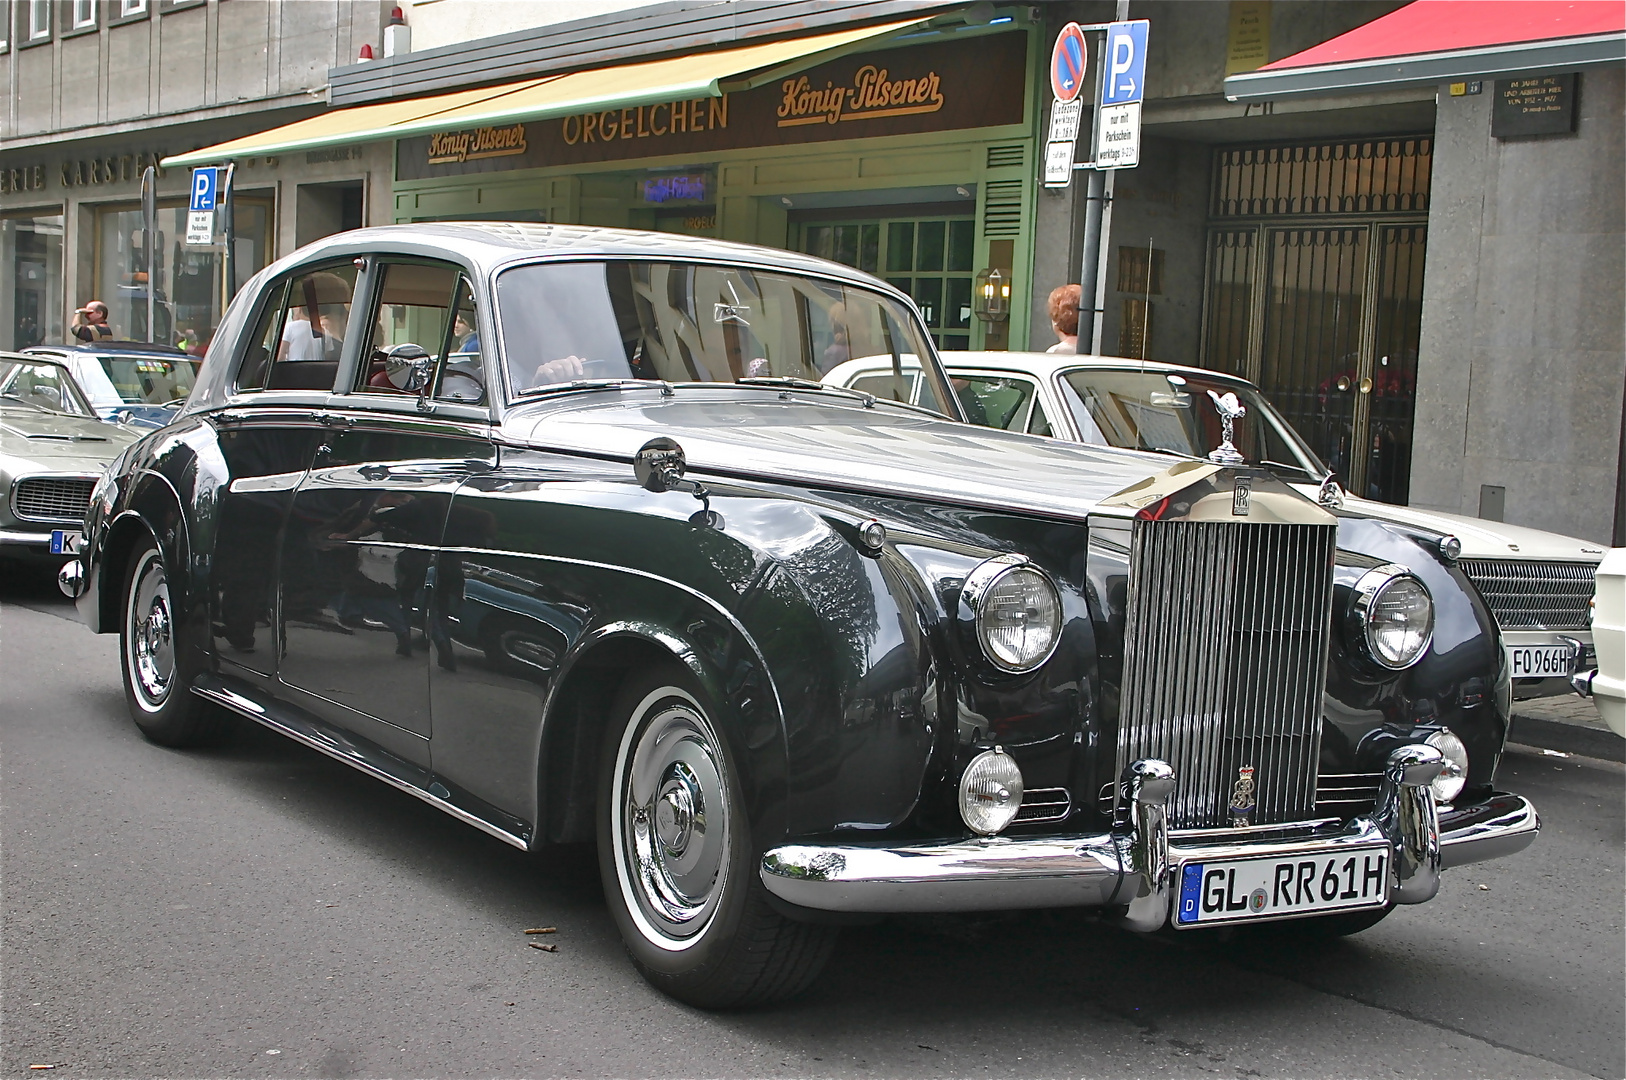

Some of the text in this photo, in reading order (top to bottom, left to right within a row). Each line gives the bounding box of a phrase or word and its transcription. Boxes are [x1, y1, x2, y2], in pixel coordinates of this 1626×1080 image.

[1108, 34, 1134, 98] P
[777, 65, 944, 125] König-Pilsener
[562, 93, 728, 145] ORGELCHEN
[1106, 129, 1131, 142] Parkschein
[428, 124, 526, 163] König-Pilsener
[61, 152, 162, 186] KARSTEN
[194, 174, 210, 209] P
[63, 535, 75, 551] K
[1202, 867, 1248, 913] GL
